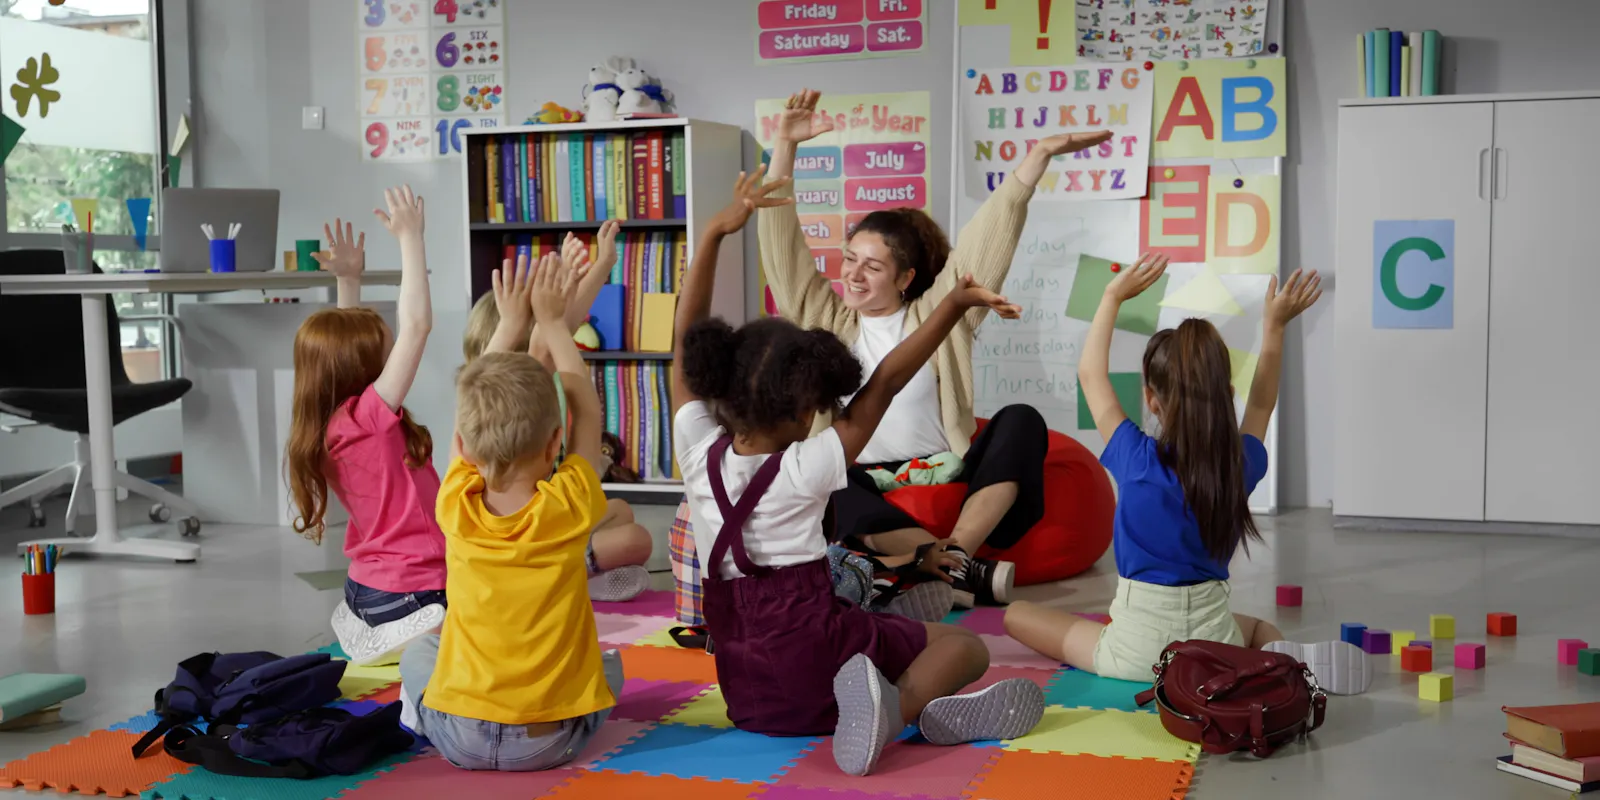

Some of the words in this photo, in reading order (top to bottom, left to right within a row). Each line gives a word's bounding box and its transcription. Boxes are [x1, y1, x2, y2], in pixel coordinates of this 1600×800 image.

[364, 0, 386, 27] 3
[434, 0, 458, 23] 4
[784, 4, 837, 20] Friday
[879, 0, 908, 12] Fri.
[470, 31, 488, 40] SIX
[774, 32, 850, 49] Saturday
[877, 26, 911, 43] Sat.
[365, 36, 387, 71] 5
[436, 31, 460, 68] 6
[466, 74, 496, 84] EIGHT
[975, 73, 995, 95] A
[1001, 73, 1018, 94] B
[1025, 71, 1042, 93] C
[1048, 71, 1068, 92] D
[1073, 70, 1090, 91] E
[1097, 69, 1113, 90] F
[1121, 68, 1140, 89] G
[365, 78, 388, 114] 7
[437, 74, 461, 112] 8
[852, 103, 864, 114] of
[872, 105, 926, 133] Year
[988, 107, 1006, 129] H
[1014, 107, 1024, 128] I
[1033, 106, 1048, 127] J
[1059, 105, 1078, 126] K
[1086, 105, 1102, 125] L
[1107, 103, 1128, 125] M
[1156, 76, 1214, 142] A
[1221, 76, 1278, 142] B
[396, 121, 422, 130] NINE
[479, 119, 497, 128] TEN
[365, 122, 389, 158] 9
[974, 140, 993, 161] N
[1000, 140, 1017, 161] O
[1098, 139, 1113, 158] S
[1121, 136, 1137, 157] T
[794, 156, 835, 172] uary
[864, 150, 904, 171] July
[637, 164, 645, 193] Book
[651, 173, 659, 208] HISTORY
[1065, 170, 1084, 192] X
[1088, 170, 1106, 191] Y
[1110, 169, 1126, 190] Z
[796, 190, 838, 206] ruary
[855, 183, 916, 203] August
[1148, 180, 1200, 248] E
[1214, 192, 1271, 257] D
[1008, 269, 1060, 293] nday
[1380, 237, 1446, 312] C
